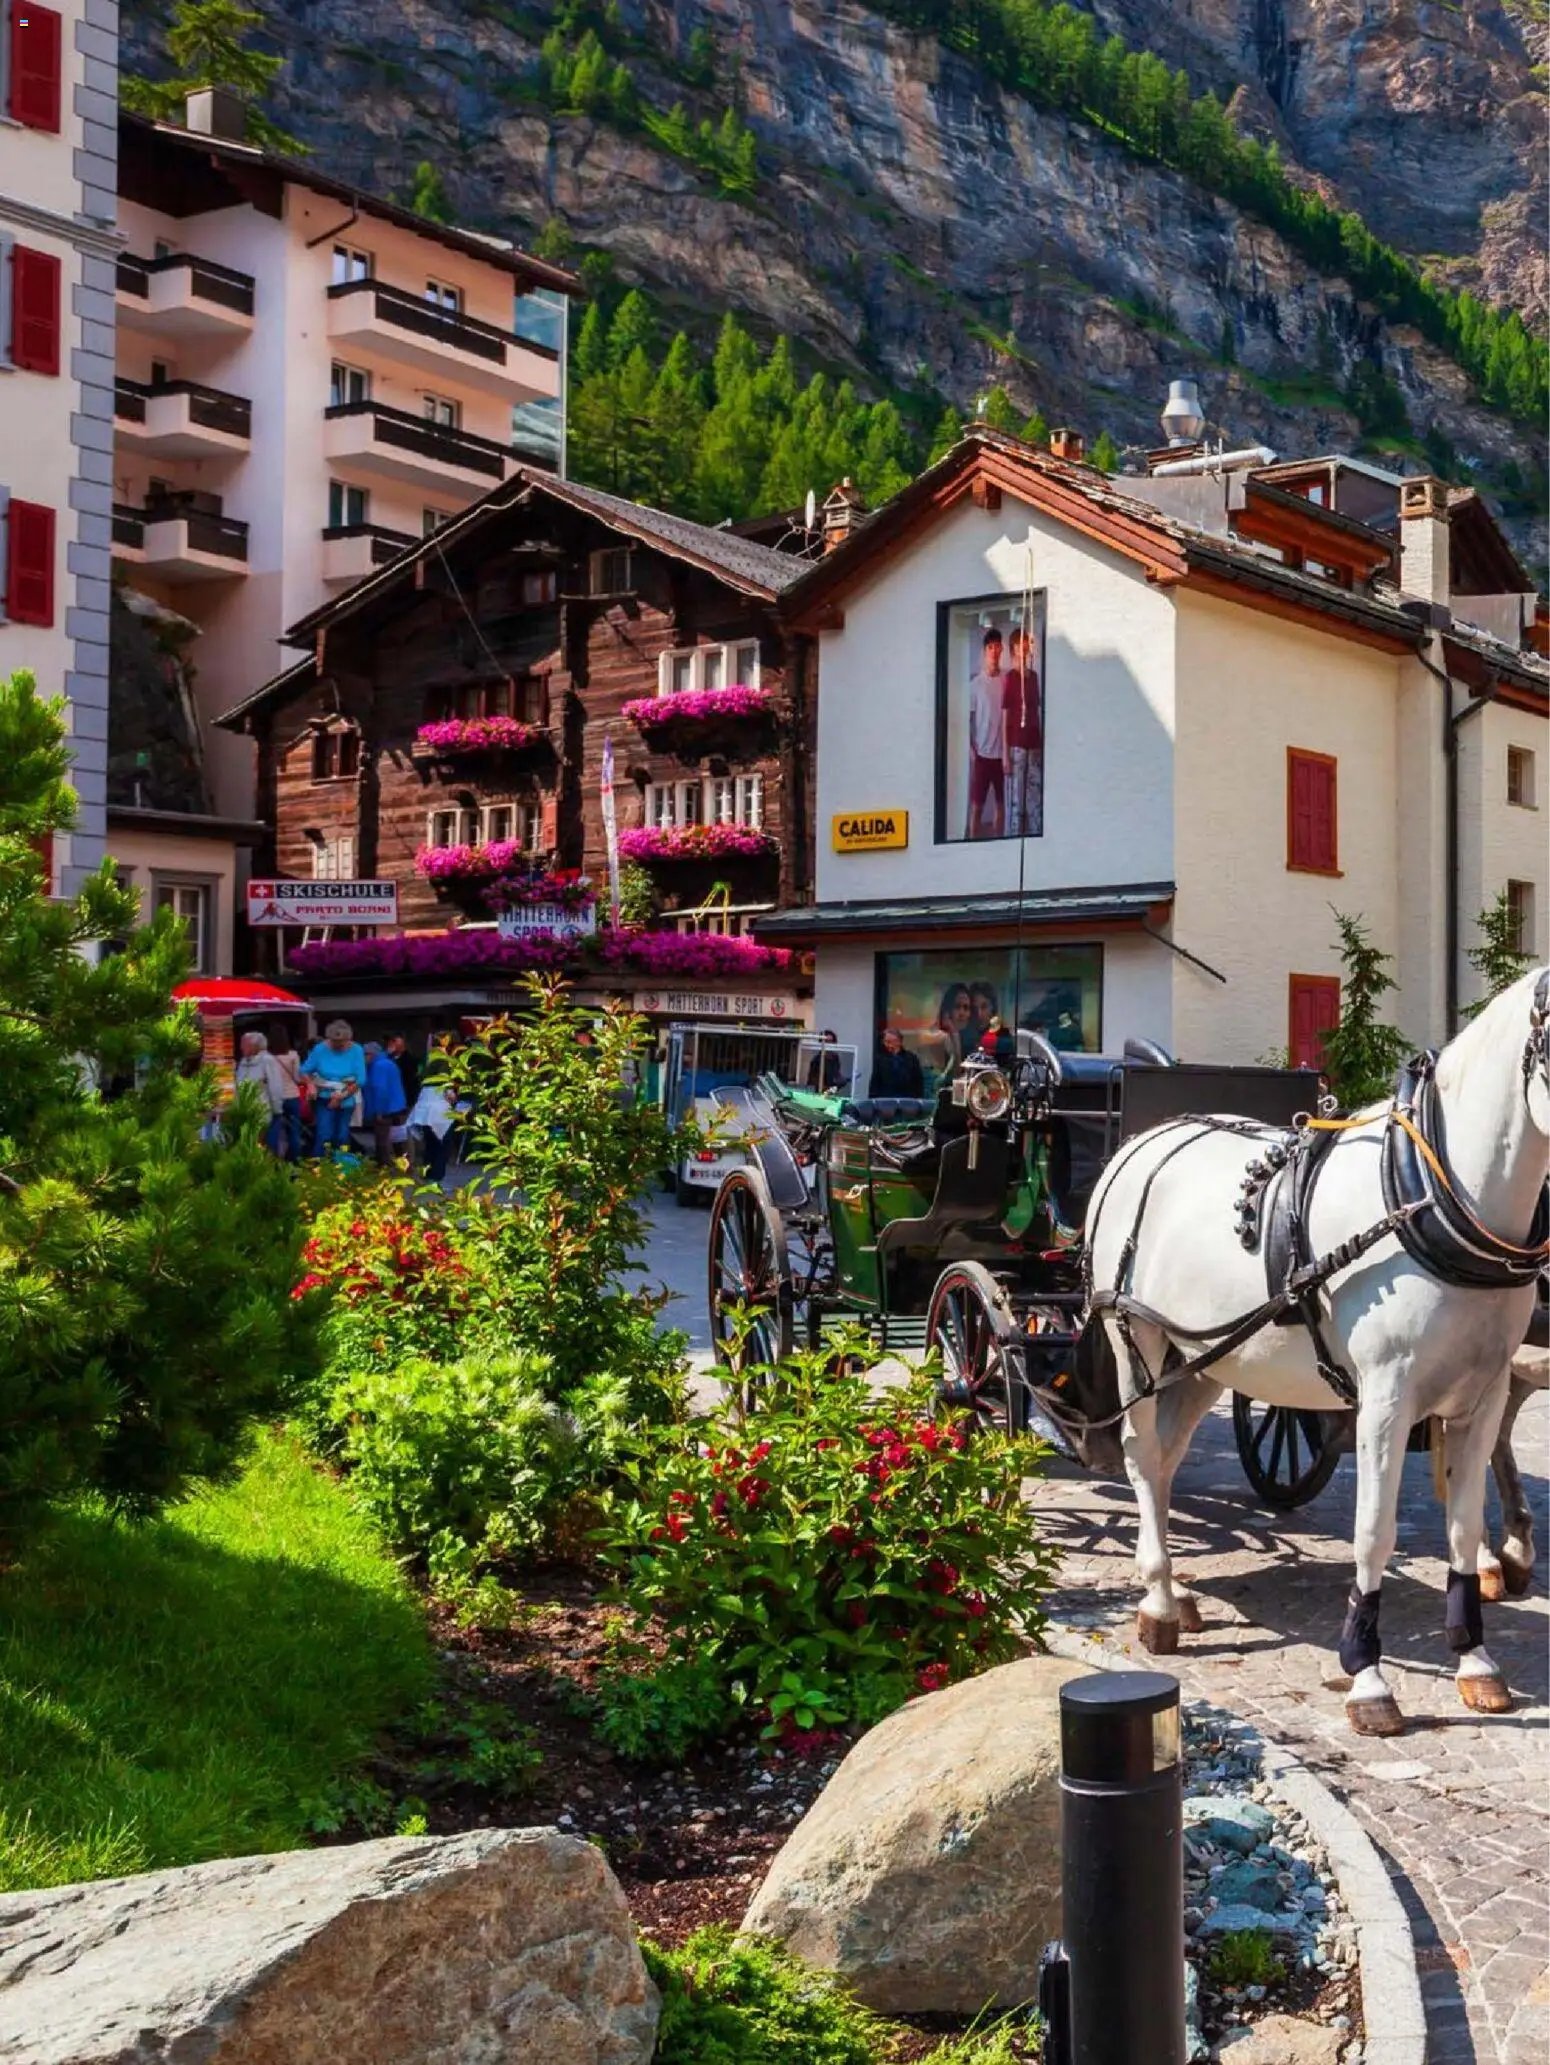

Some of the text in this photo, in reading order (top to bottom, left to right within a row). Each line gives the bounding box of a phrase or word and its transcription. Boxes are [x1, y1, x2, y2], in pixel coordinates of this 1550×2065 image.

[839, 817, 896, 838] CALIDA
[280, 884, 391, 897] SKISCHULE
[667, 993, 763, 1014] MATTERHORN SPORT
